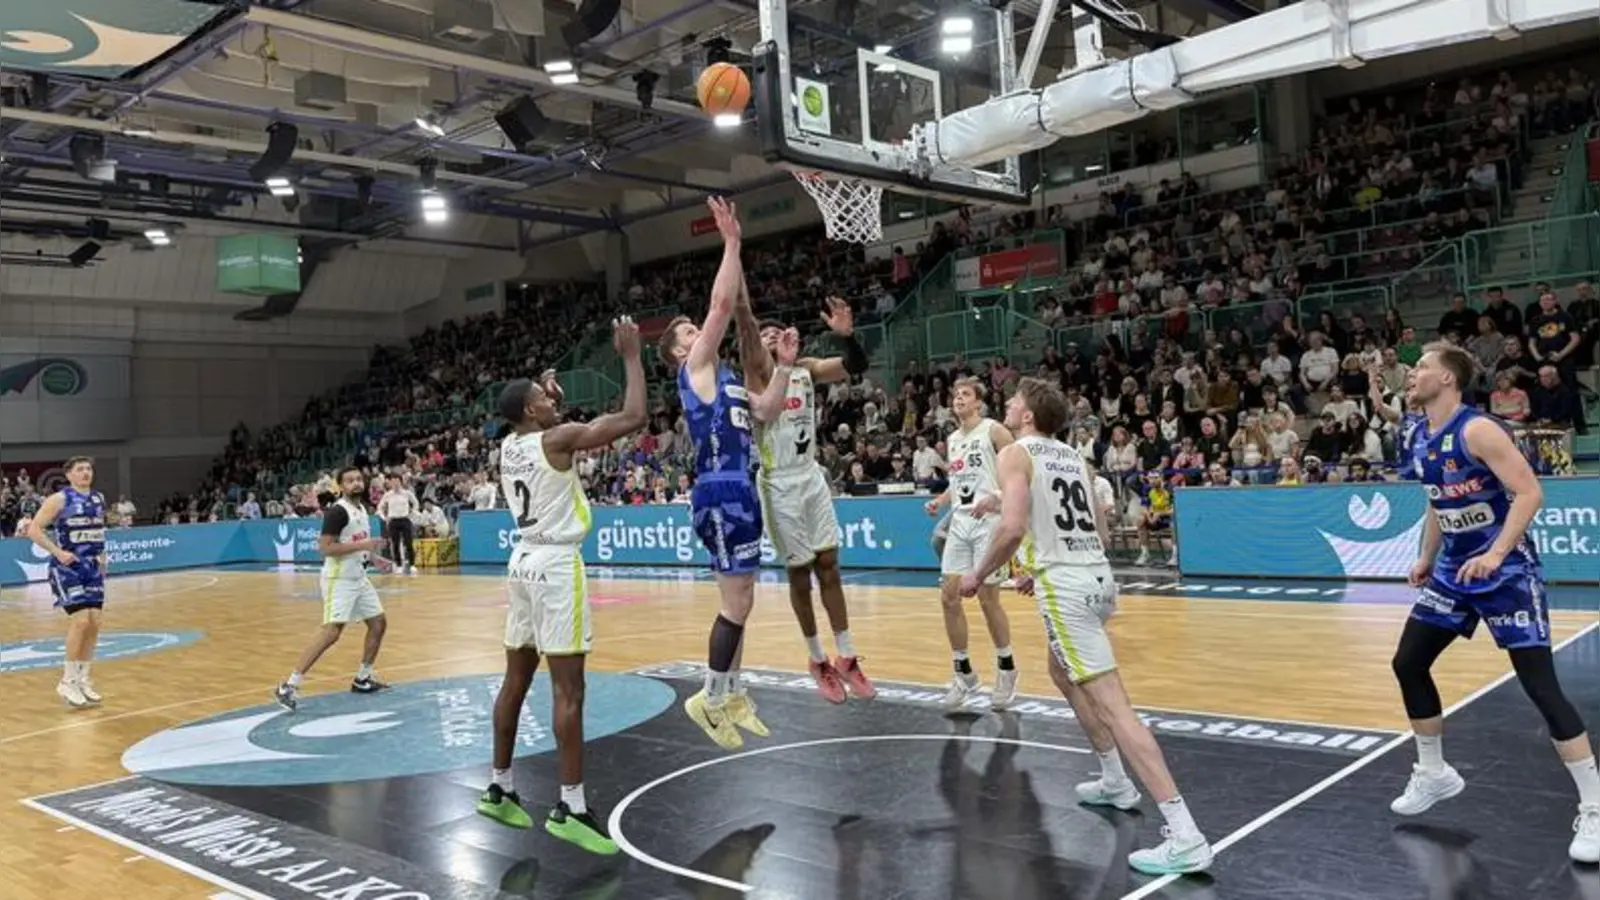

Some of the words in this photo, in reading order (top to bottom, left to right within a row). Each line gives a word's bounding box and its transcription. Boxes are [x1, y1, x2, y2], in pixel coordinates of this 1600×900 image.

[513, 479, 538, 528] 2
[1051, 477, 1096, 532] 39
[597, 518, 704, 560] günstig.
